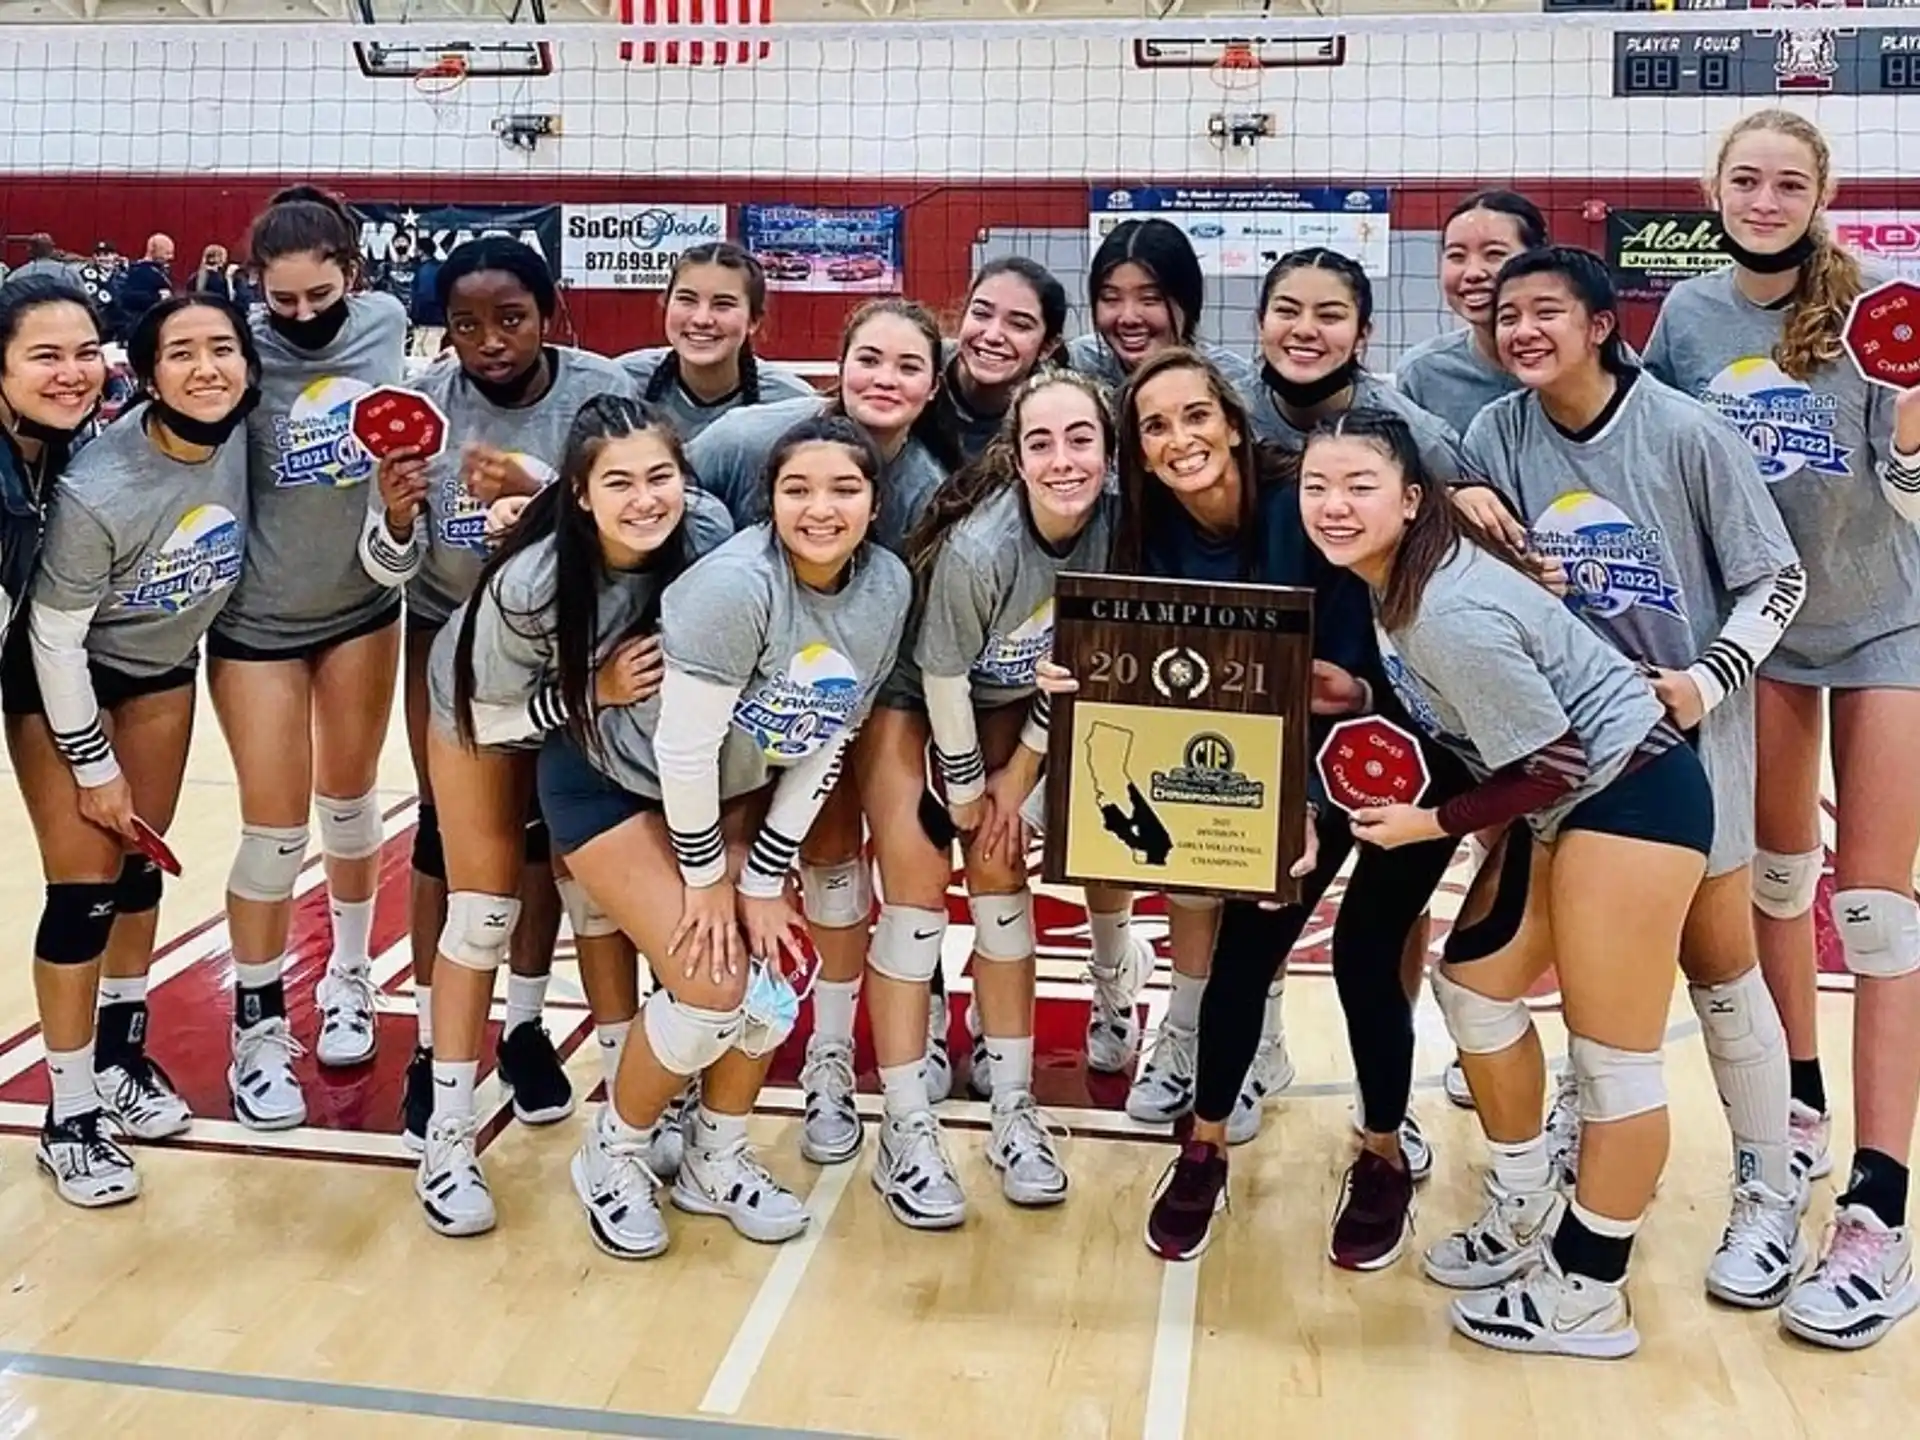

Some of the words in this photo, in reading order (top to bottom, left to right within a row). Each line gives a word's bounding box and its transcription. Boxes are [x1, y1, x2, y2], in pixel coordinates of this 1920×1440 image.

[1626, 36, 1681, 53] PLAYER
[1693, 35, 1741, 52] FOULS
[1880, 35, 1920, 51] PLAY
[359, 221, 549, 262] MIKAA
[1686, 256, 1734, 265] Rem
[1876, 357, 1920, 374] CHAM
[1718, 408, 1837, 429] AMPIONS
[277, 422, 351, 449] CHAM
[290, 449, 330, 468] 2021
[449, 521, 482, 535] 202
[1536, 545, 1662, 563] HAMPIONS
[1614, 571, 1658, 590] 2022
[1091, 599, 1279, 629] CHAMPIONS
[1089, 651, 1139, 684] 20
[1221, 661, 1268, 695] 21
